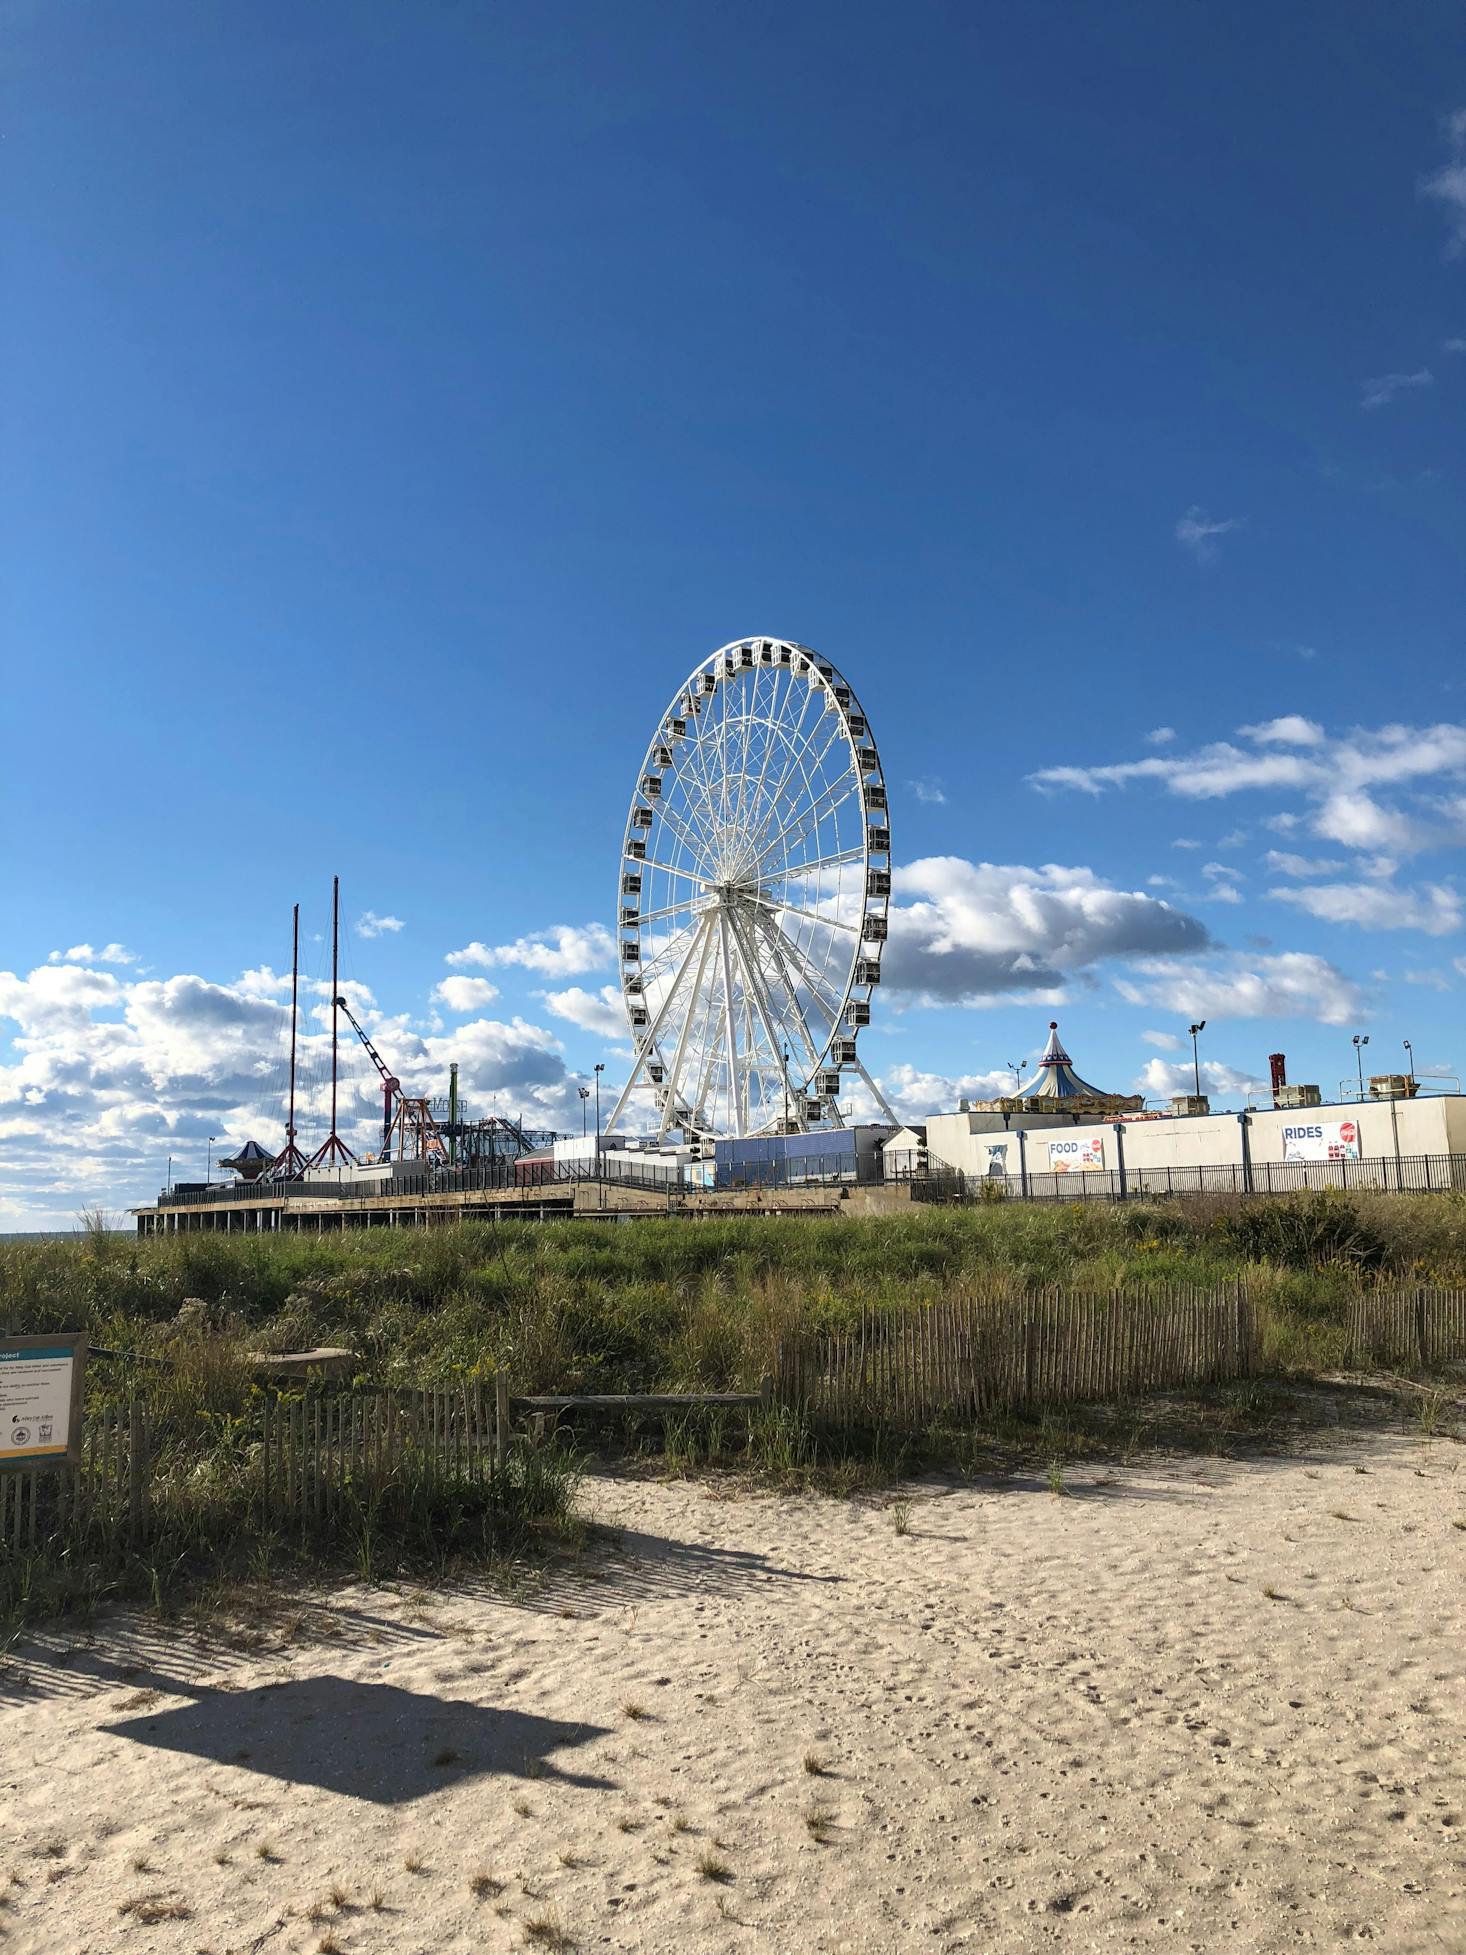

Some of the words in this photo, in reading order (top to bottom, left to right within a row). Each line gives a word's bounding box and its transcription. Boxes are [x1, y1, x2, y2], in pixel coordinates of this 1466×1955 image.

[1285, 1126, 1323, 1139] RIDES
[1050, 1142, 1078, 1154] FOOD
[0, 1352, 20, 1360] roject
